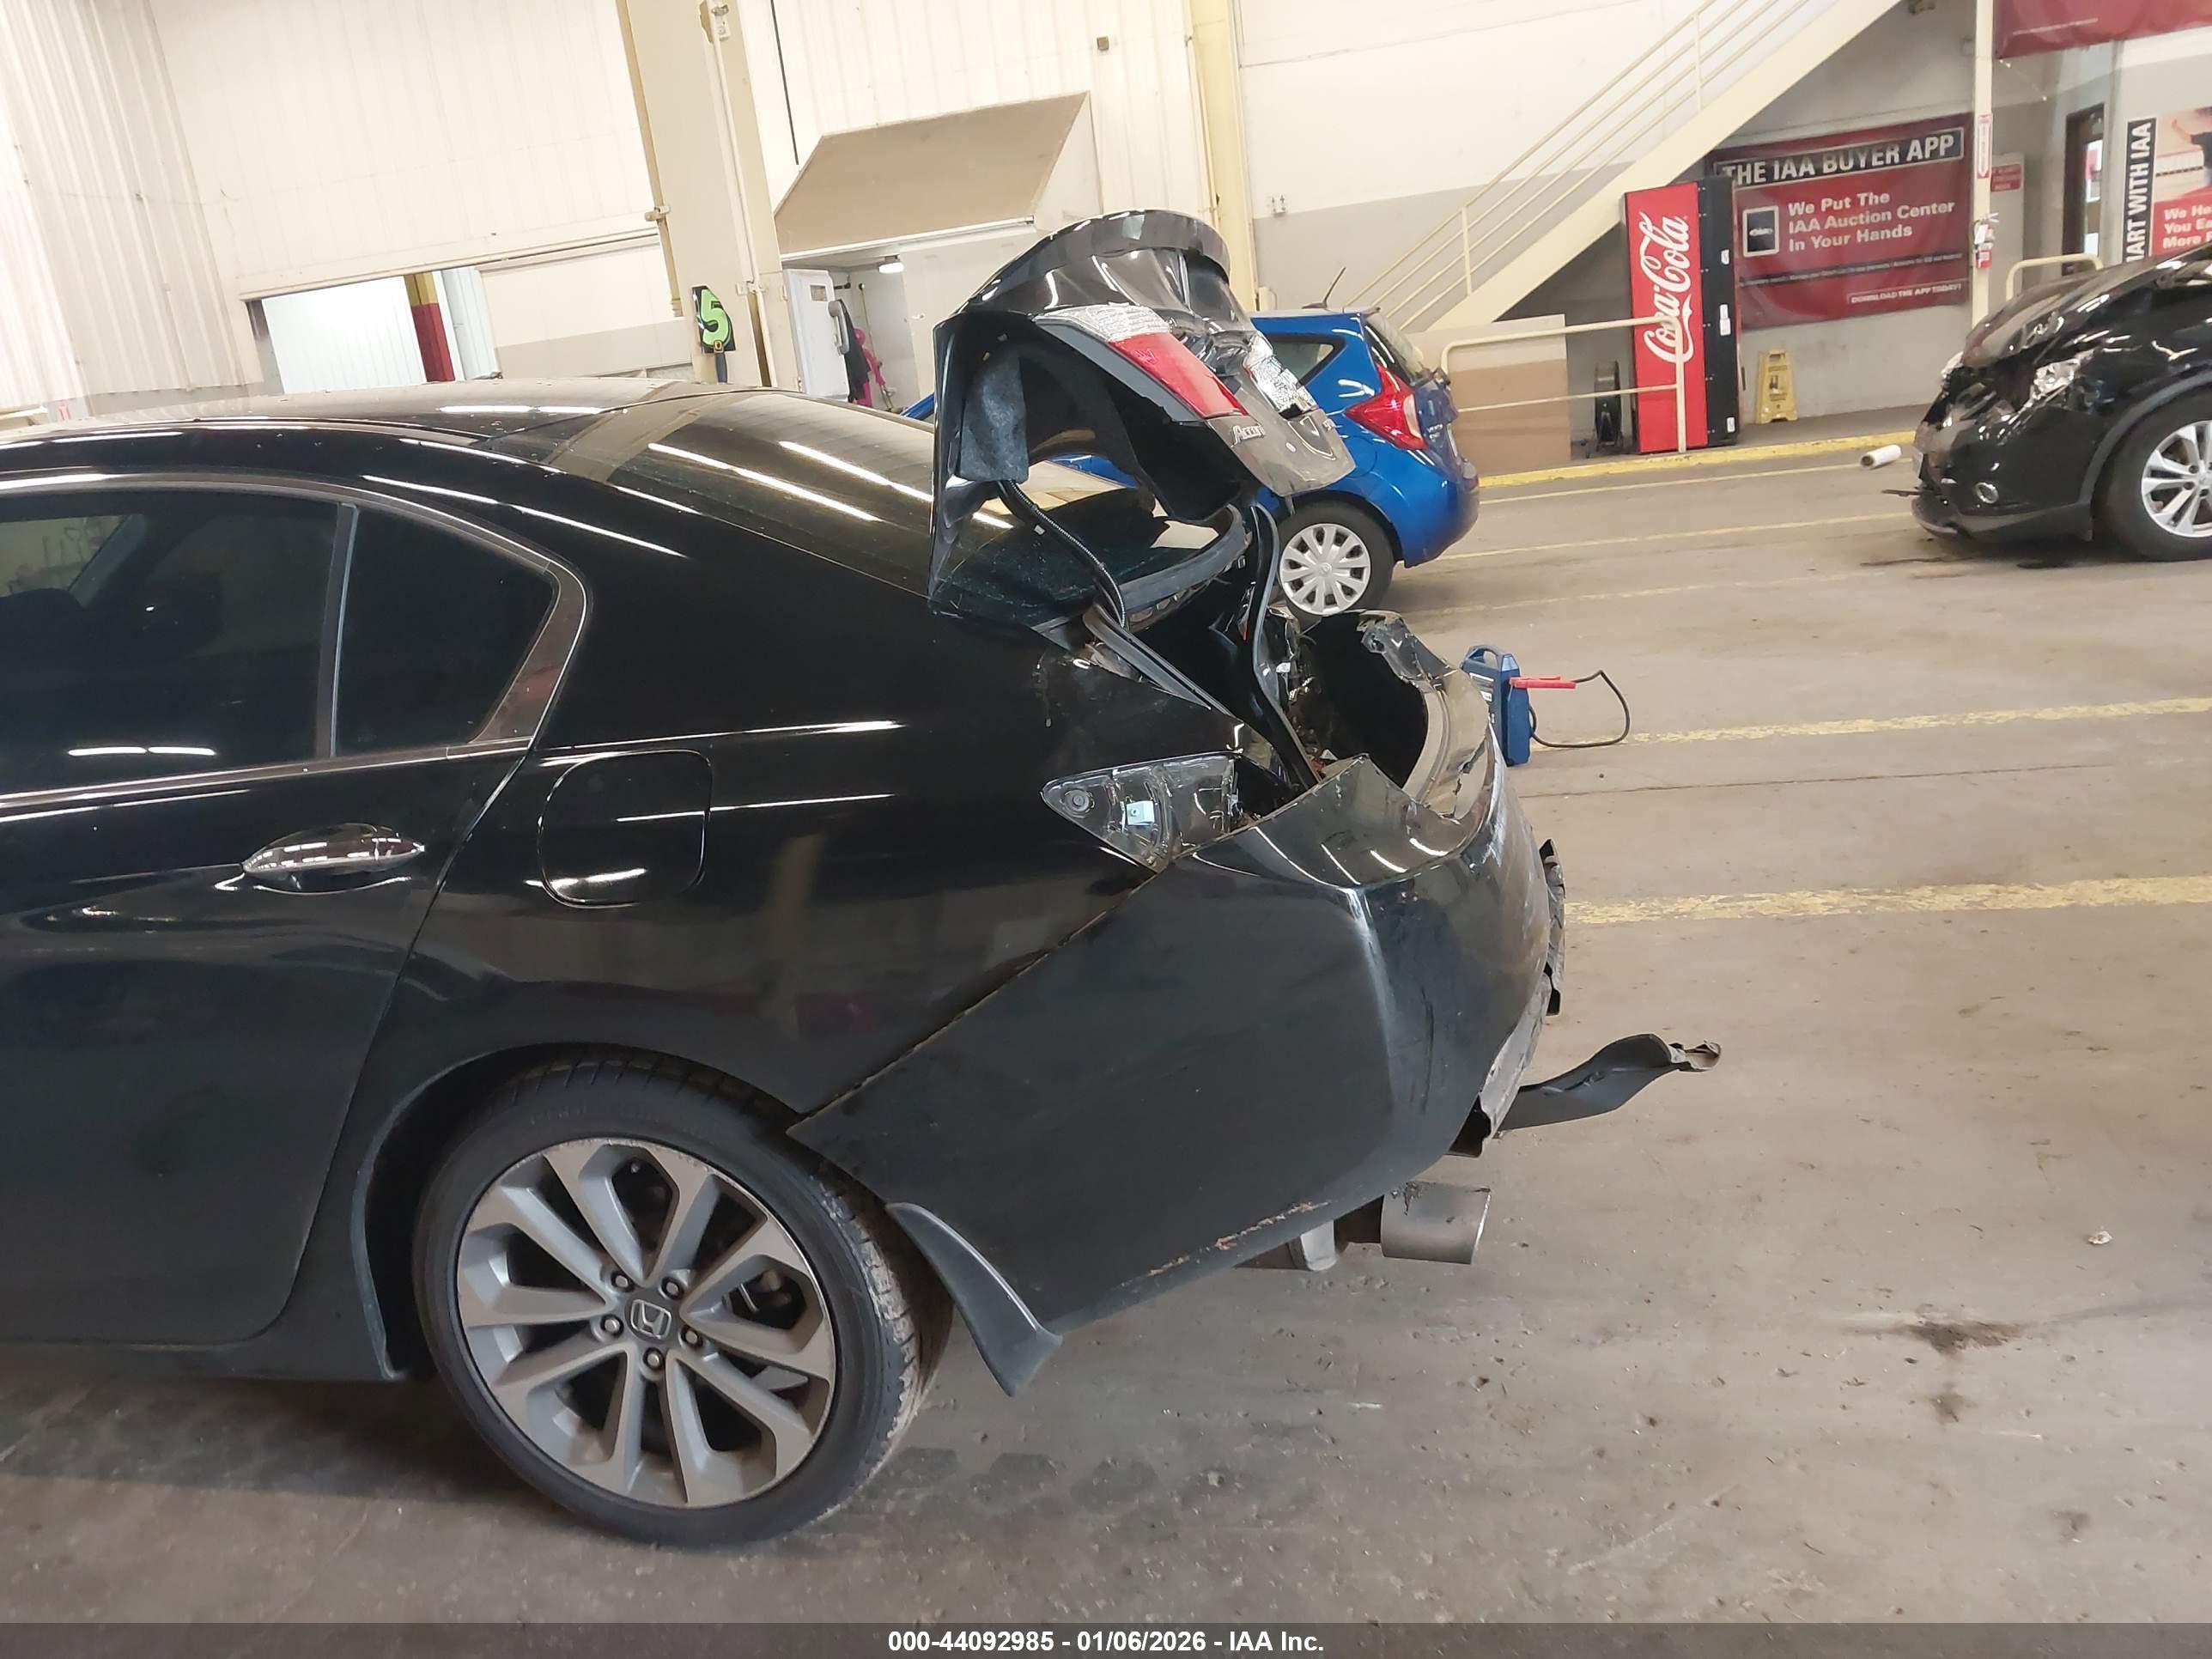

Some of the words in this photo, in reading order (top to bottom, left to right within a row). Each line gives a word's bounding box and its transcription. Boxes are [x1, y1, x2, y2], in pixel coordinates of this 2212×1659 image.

[2130, 123, 2152, 159] IAA
[1723, 161, 1766, 185] THE
[1774, 155, 1815, 179] IAA
[1822, 143, 1900, 174] BUYER
[1906, 134, 1954, 161] APP
[1788, 202, 1814, 216] We
[1821, 197, 1851, 212] Put
[1856, 191, 1890, 206] The
[2128, 163, 2149, 216] WITH
[1789, 218, 1821, 234] IAA
[1825, 210, 1892, 229] Auction
[1897, 201, 1955, 219] Center
[2164, 208, 2187, 221] We
[2164, 222, 2191, 234] You
[1789, 239, 1806, 252] In
[1811, 234, 1850, 249] Your
[1856, 224, 1913, 242] Hands
[2162, 235, 2202, 249] More
[1915, 287, 1931, 296] APP
[700, 289, 730, 347] 5
